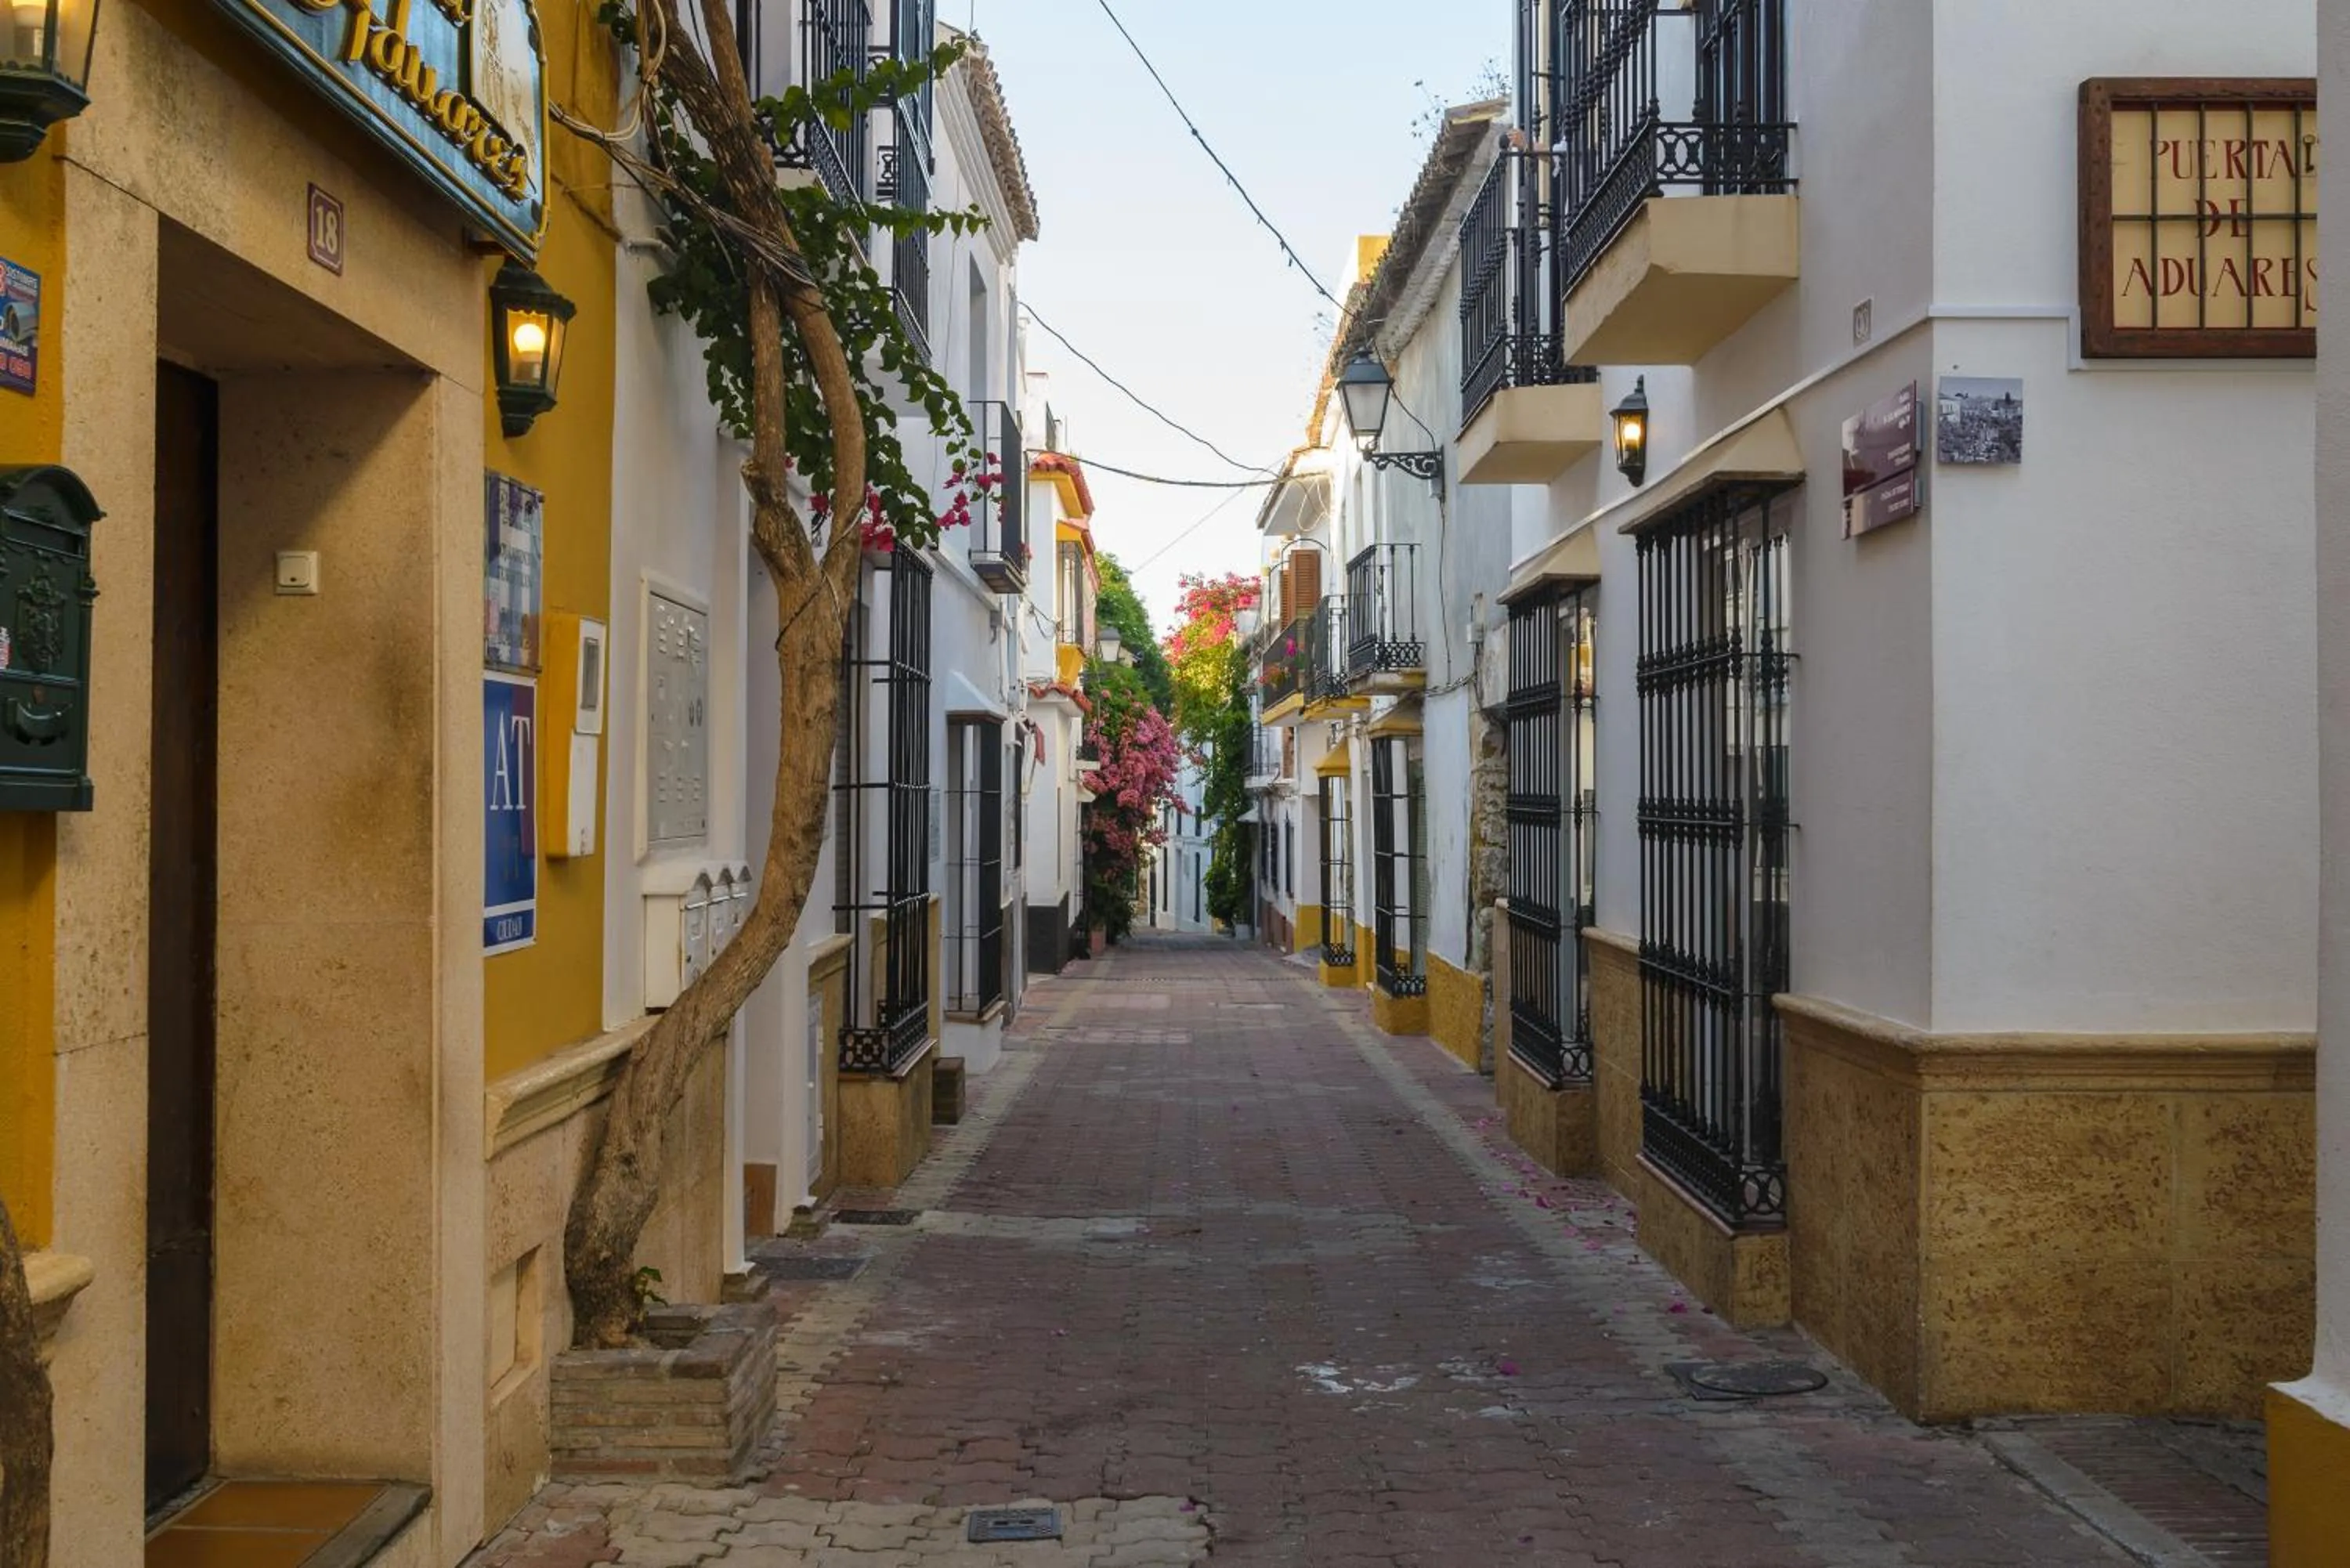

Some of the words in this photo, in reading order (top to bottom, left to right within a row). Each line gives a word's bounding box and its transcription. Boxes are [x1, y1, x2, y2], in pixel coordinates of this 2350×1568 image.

[2150, 139, 2297, 180] PUERTA
[314, 204, 338, 255] 18
[2194, 197, 2251, 239] DE
[490, 710, 530, 811] AT
